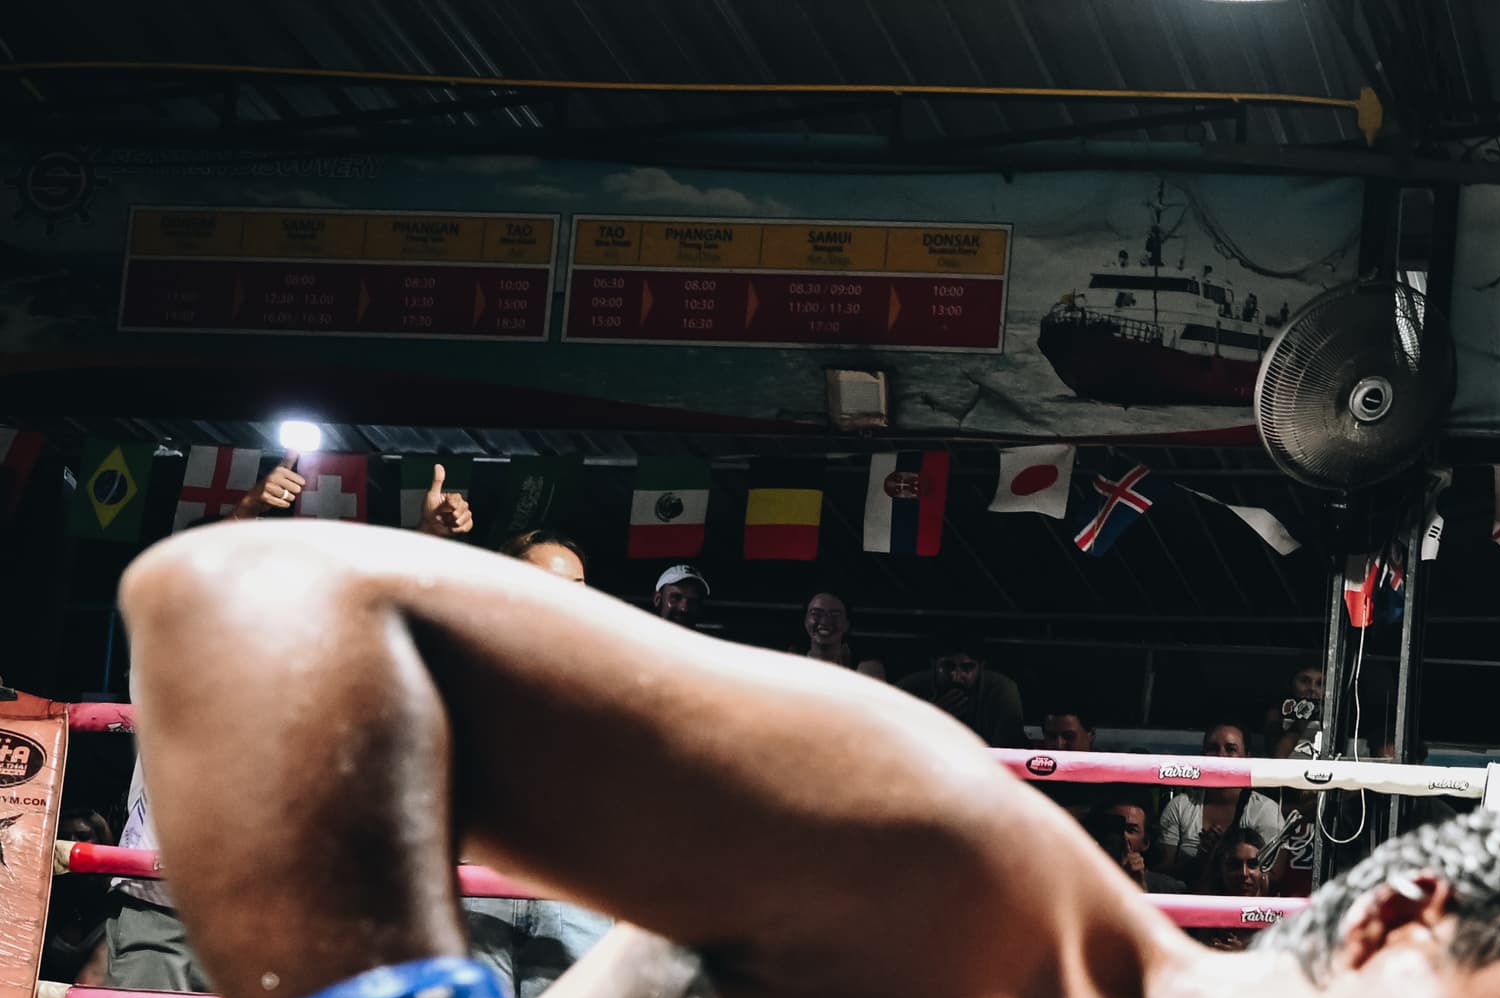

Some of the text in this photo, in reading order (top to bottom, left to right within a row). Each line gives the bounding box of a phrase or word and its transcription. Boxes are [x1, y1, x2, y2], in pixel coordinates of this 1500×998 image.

[392, 222, 460, 236] PHANGAN
[506, 224, 533, 236] TAO
[598, 226, 625, 239] TAO
[665, 228, 733, 242] PHANGAN
[808, 230, 852, 244] SAMUI
[923, 233, 982, 248] DONSAK
[932, 284, 964, 297] 10:00
[1158, 763, 1200, 780] Fairtex
